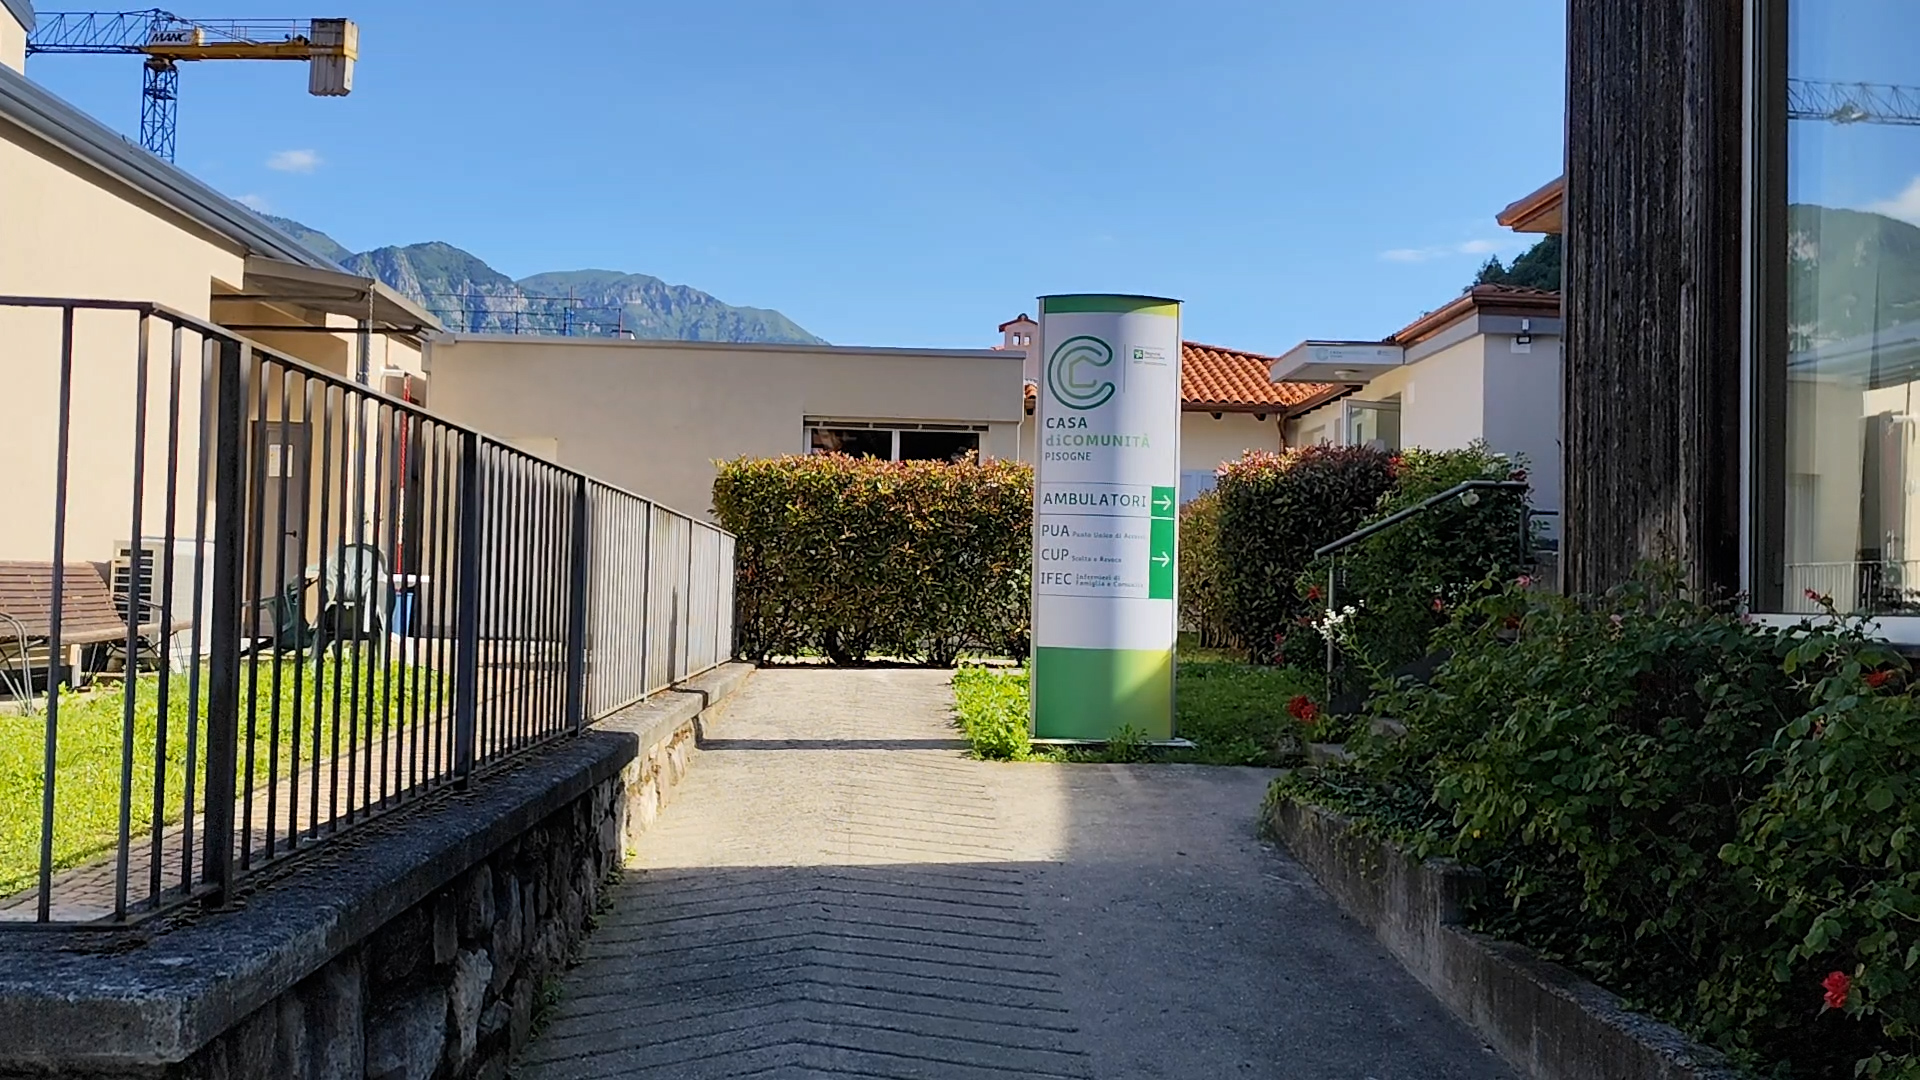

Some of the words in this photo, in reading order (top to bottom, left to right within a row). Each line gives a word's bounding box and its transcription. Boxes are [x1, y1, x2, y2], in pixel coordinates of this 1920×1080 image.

[1046, 417, 1088, 429] CASA
[1045, 452, 1091, 461] PISOGNE
[1043, 493, 1146, 507] AMBULATORI
[1041, 525, 1070, 537] PUA
[1041, 549, 1069, 561] CUP
[1040, 572, 1072, 584] IFEC
